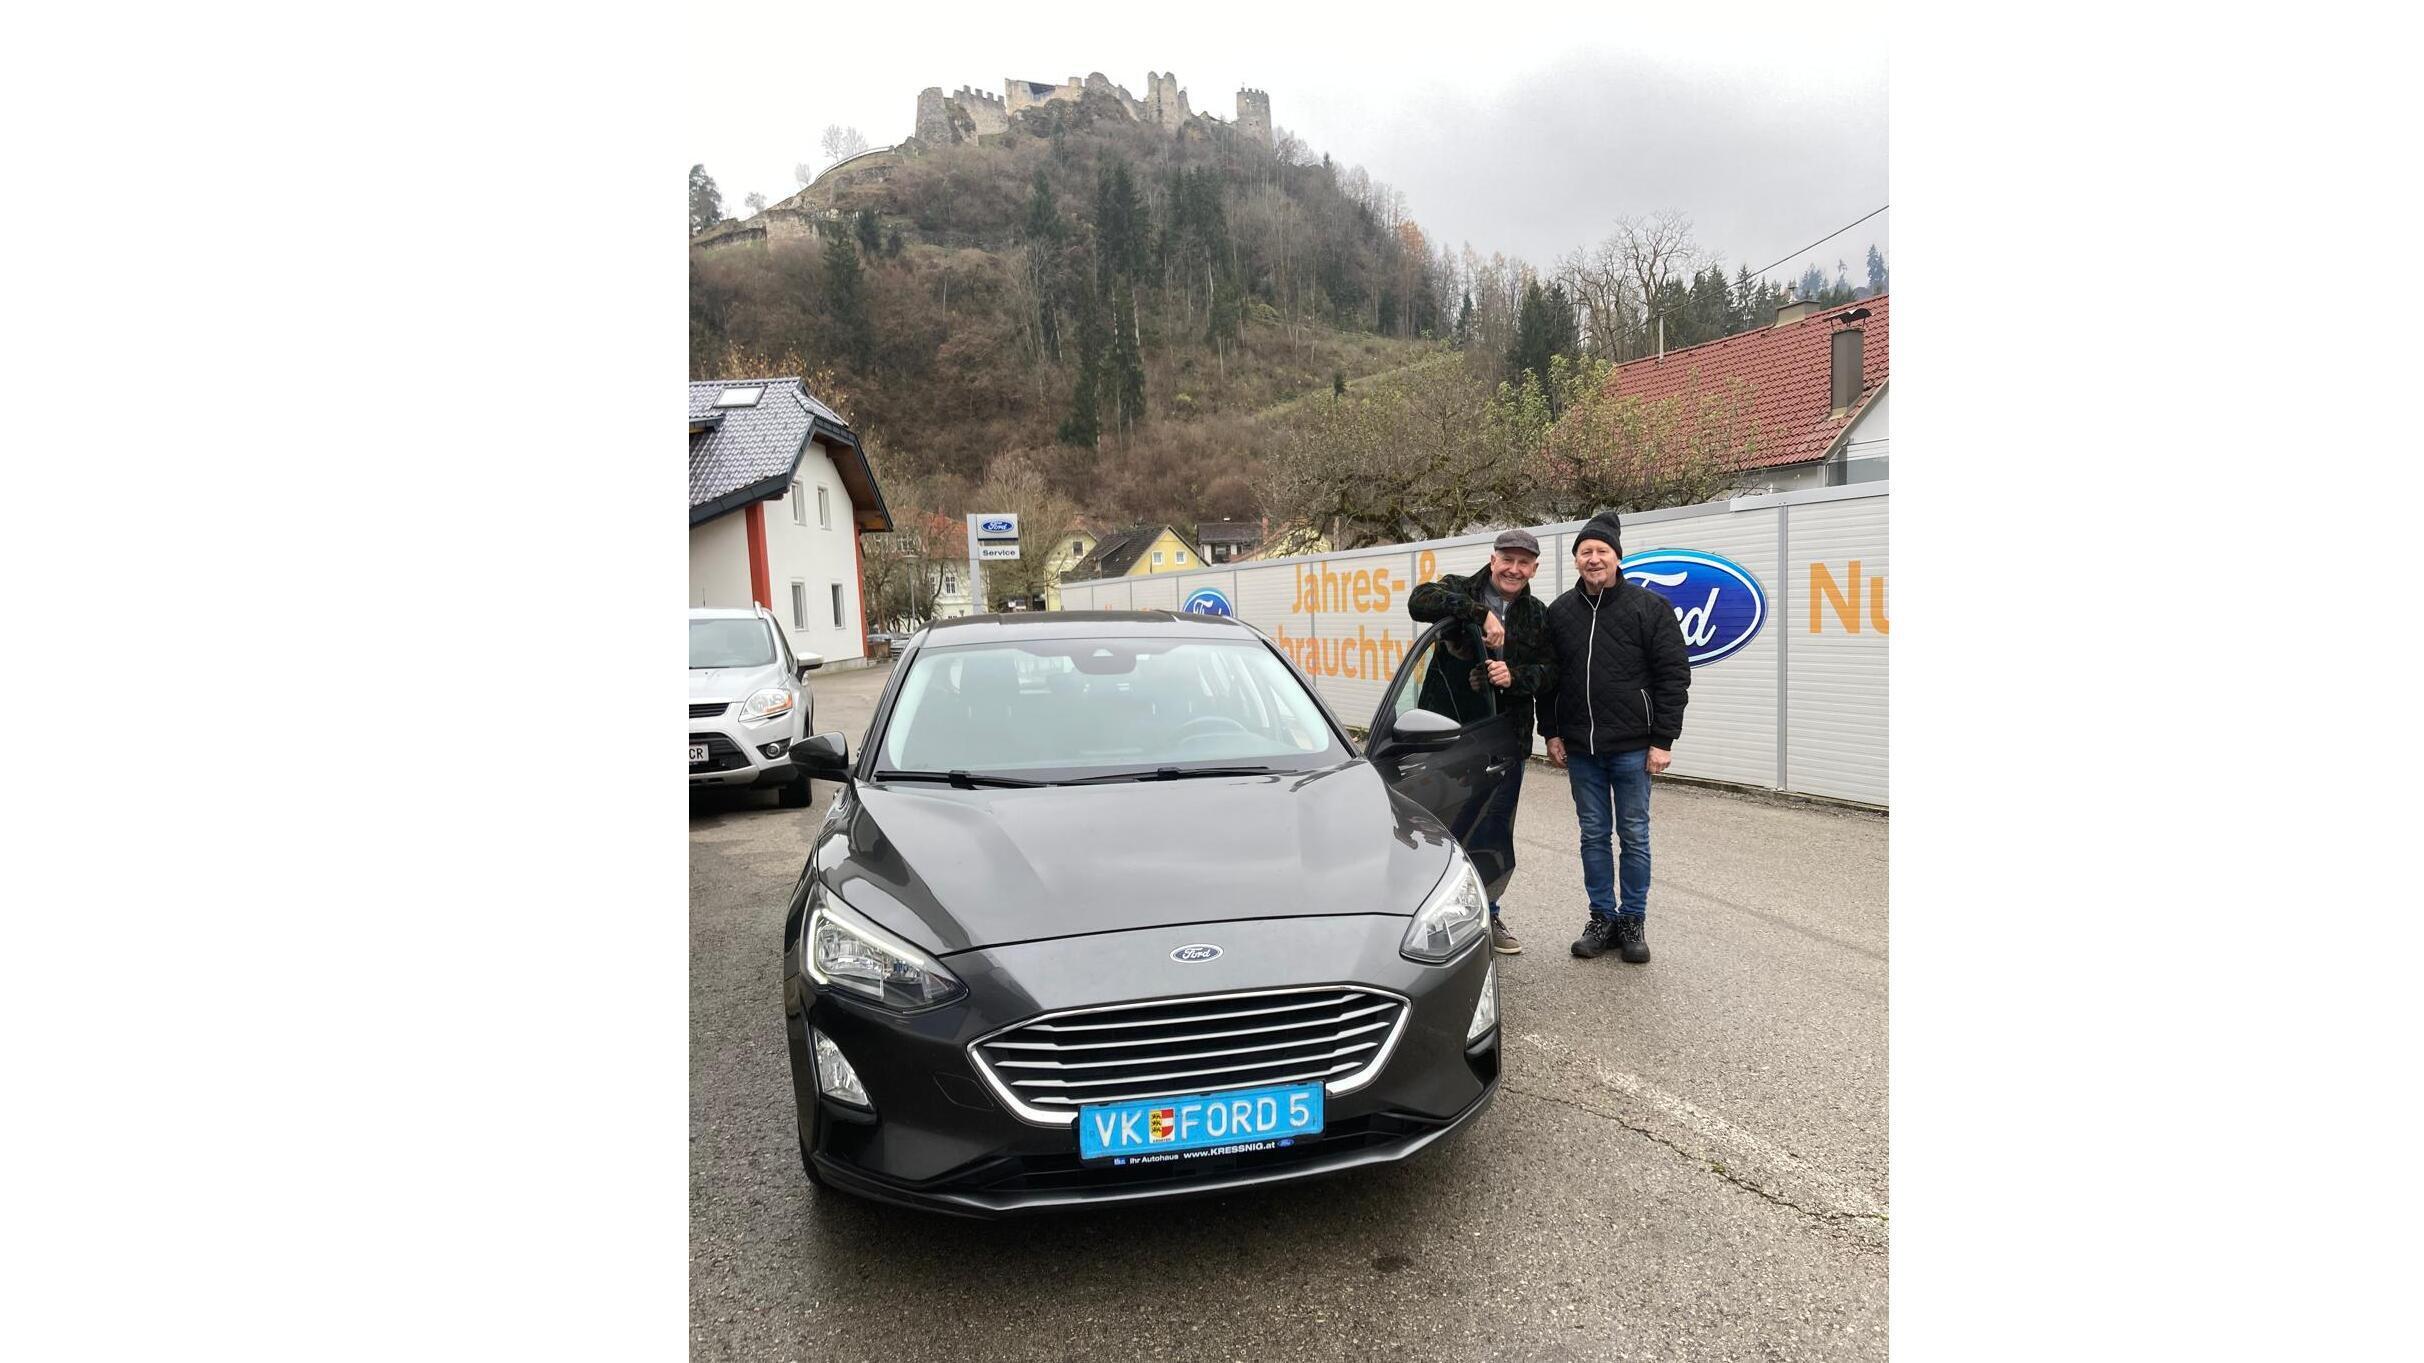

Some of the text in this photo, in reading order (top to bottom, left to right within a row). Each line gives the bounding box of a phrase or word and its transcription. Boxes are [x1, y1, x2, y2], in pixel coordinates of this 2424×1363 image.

[1292, 560, 1406, 613] Jahres-
[1182, 946, 1211, 959] Ford
[1095, 1092, 1310, 1148] VK FORD 5
[1129, 1157, 1141, 1165] Ihr
[1141, 1154, 1179, 1164] Autohaus
[1183, 1141, 1276, 1160] www.KRESSNIG.at
